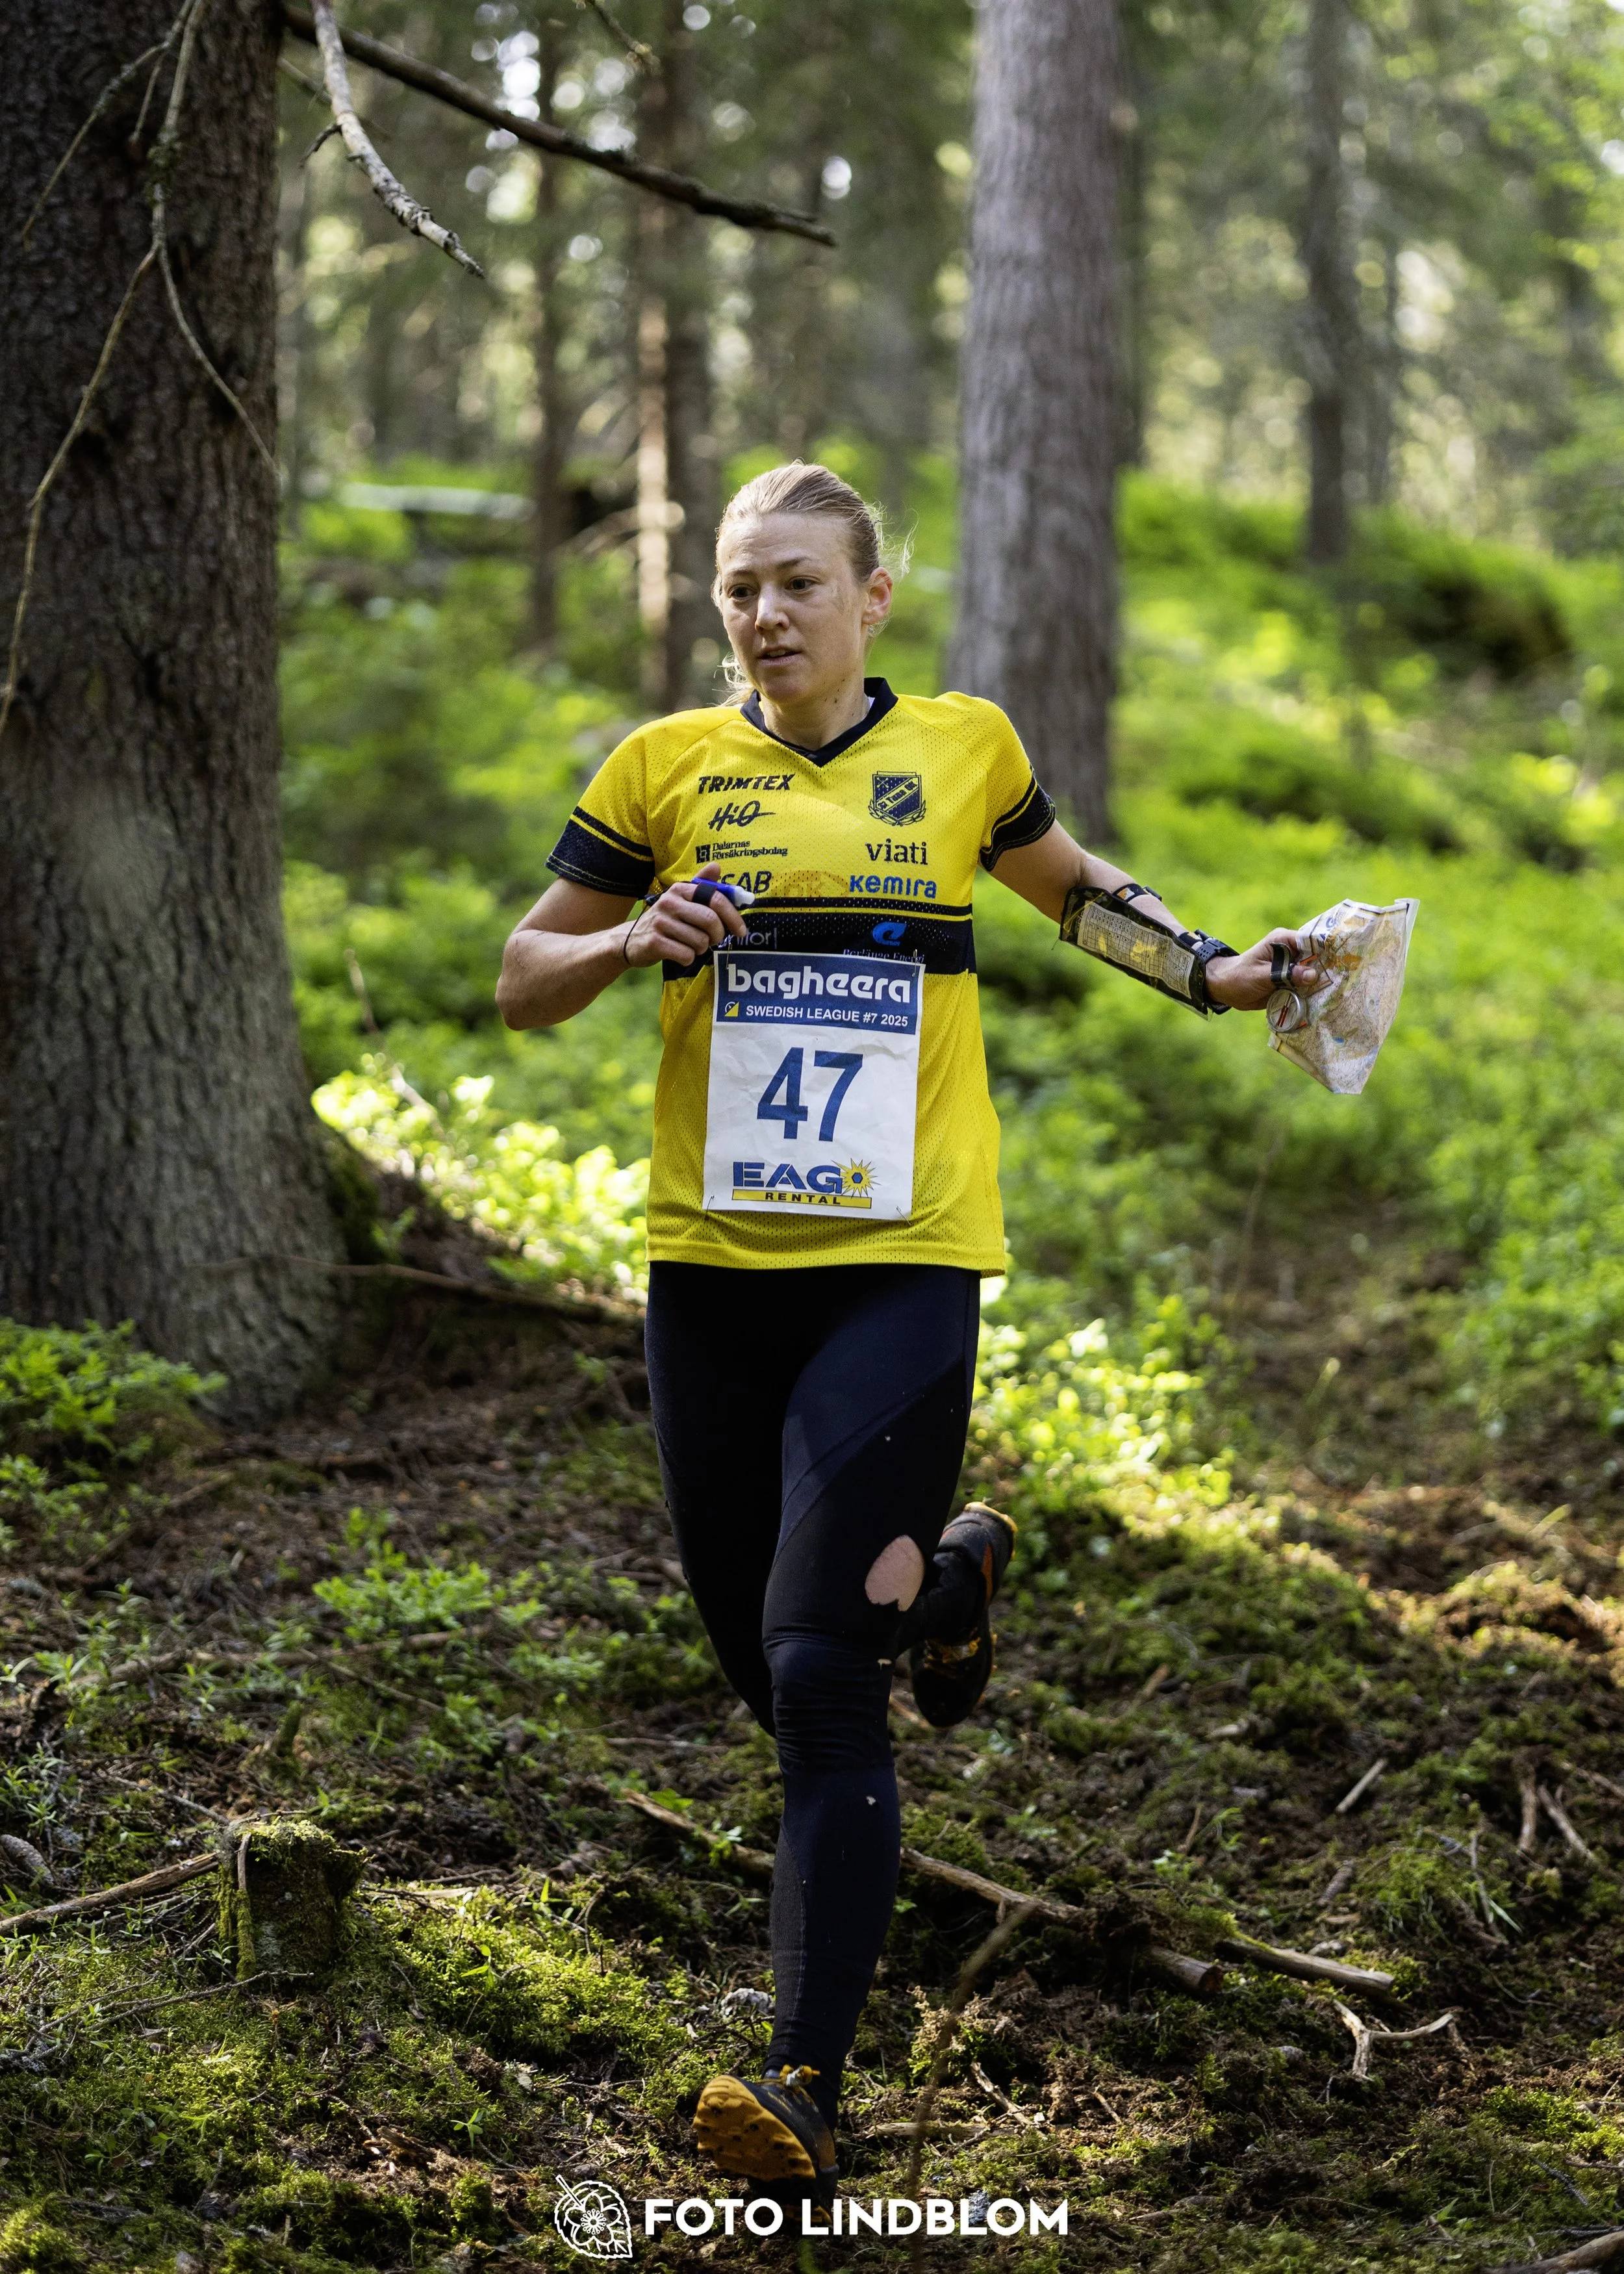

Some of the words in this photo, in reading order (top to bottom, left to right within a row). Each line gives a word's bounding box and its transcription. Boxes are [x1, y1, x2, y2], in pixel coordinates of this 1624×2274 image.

[698, 773, 795, 794] TRIMTEX
[865, 838, 928, 865] viati
[728, 964, 910, 1003] bagheera
[746, 1005, 804, 1018] SWEDISH
[807, 1008, 859, 1022] LEAGUE
[863, 1014, 878, 1024] #7
[881, 1014, 908, 1027] 2025
[757, 1047, 863, 1142] 47
[733, 1162, 843, 1194] EAG
[765, 1192, 841, 1205] RENTAL
